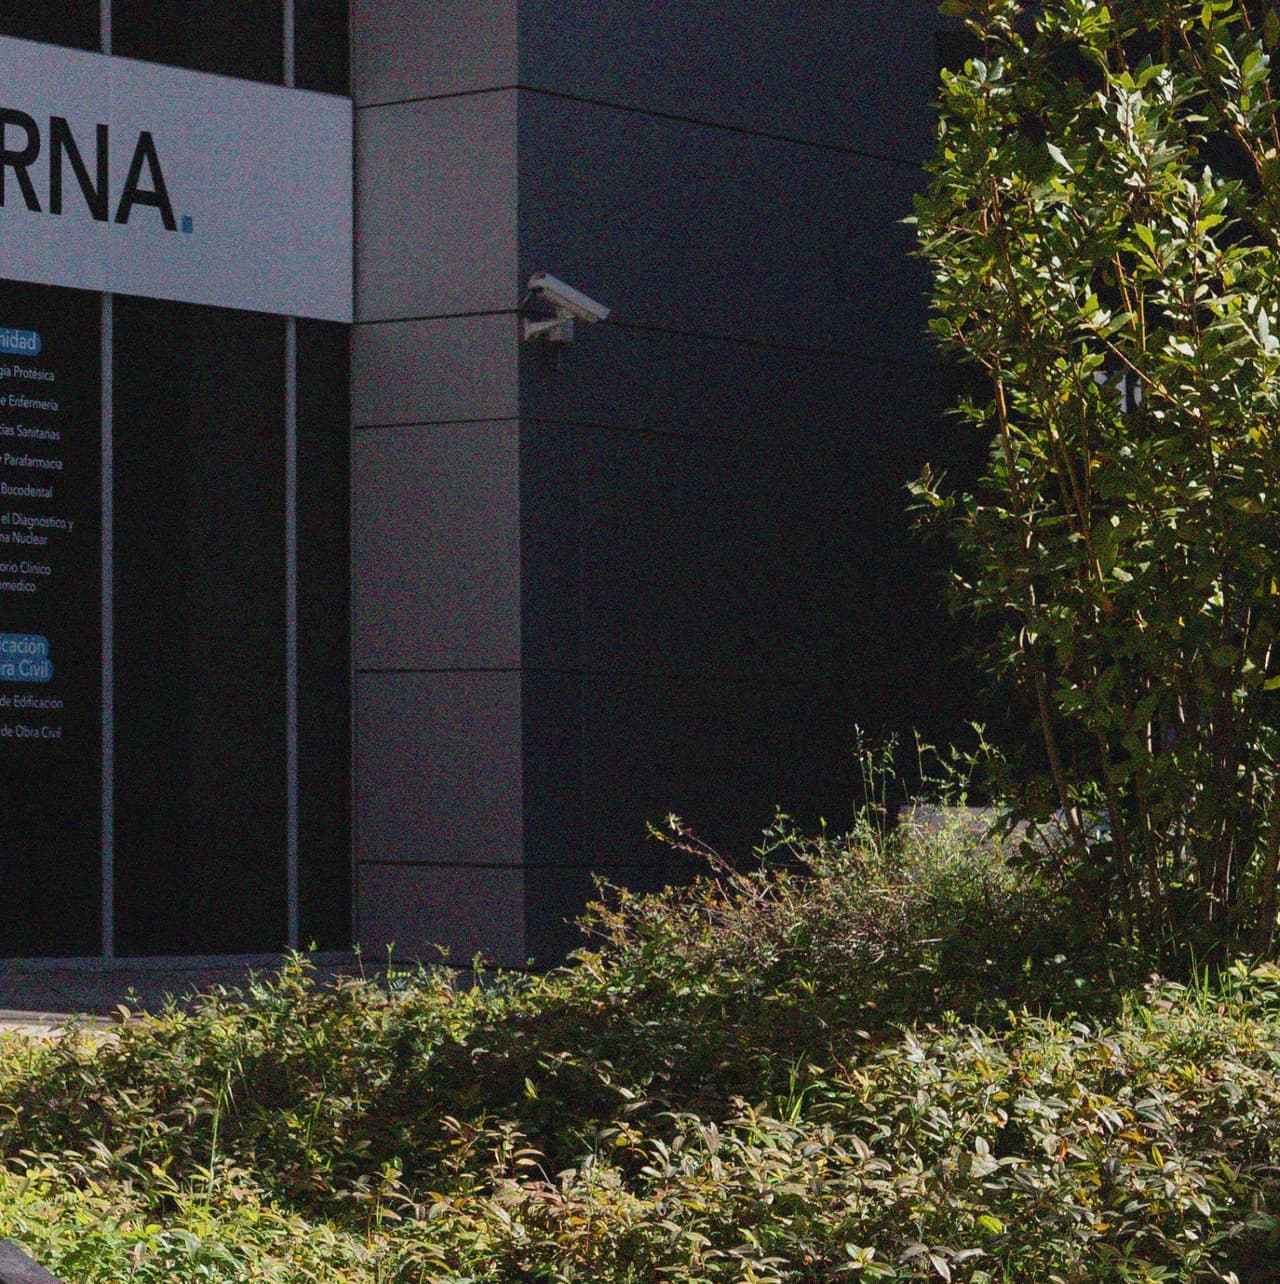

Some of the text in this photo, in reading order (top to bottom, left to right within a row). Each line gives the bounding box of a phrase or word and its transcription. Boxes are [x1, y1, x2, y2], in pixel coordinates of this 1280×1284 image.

[17, 426, 60, 440] Sanitarias
[4, 453, 62, 470] Parafarmacia
[1, 483, 53, 498] Bucodental
[2, 513, 9, 523] el
[67, 520, 73, 530] y
[13, 532, 47, 545] Nuclear
[19, 661, 48, 677] Civil
[0, 695, 11, 707] de
[1, 725, 13, 736] de
[16, 725, 39, 738] Obra
[42, 726, 62, 739] Civil
